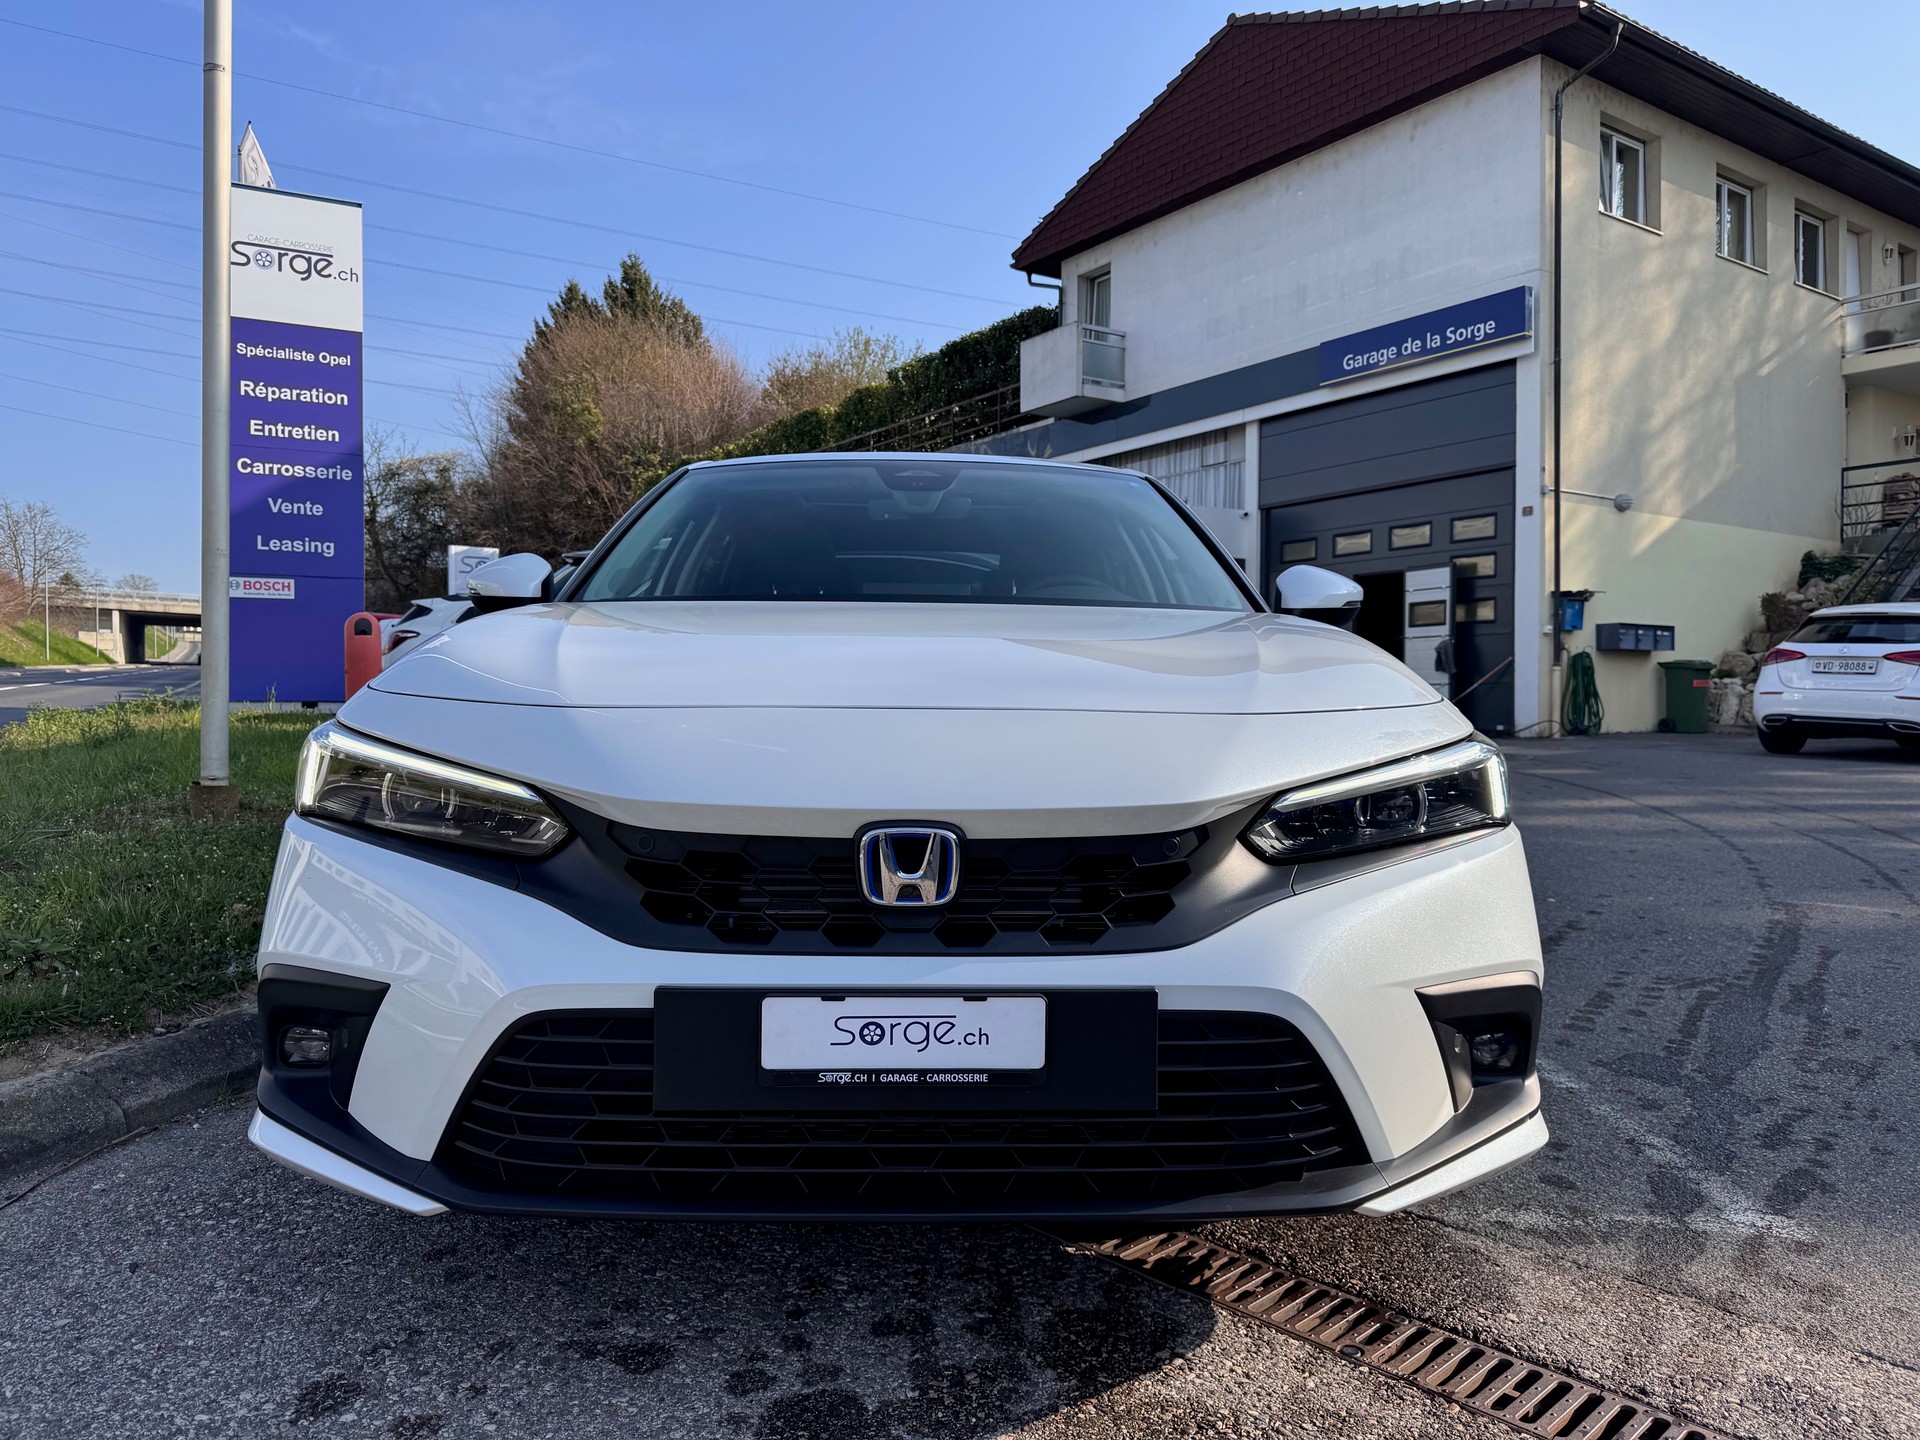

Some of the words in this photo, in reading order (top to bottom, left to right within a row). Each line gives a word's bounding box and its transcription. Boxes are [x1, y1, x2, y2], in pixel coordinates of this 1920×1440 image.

[236, 342, 315, 362] Spécialiste
[318, 352, 351, 367] Opel
[1343, 346, 1397, 370] Garage
[1401, 338, 1421, 356] de
[1426, 332, 1441, 349] la
[1446, 320, 1496, 345] Sorge
[239, 380, 348, 406] Réparation
[249, 419, 340, 442] Entretien
[236, 457, 353, 481] Carrosserie
[267, 497, 324, 516] Vente
[256, 535, 335, 557] Leasing
[243, 580, 291, 592] BOSCH
[879, 1073, 919, 1083] GARAGE
[926, 1073, 989, 1083] CARROSSERIE
